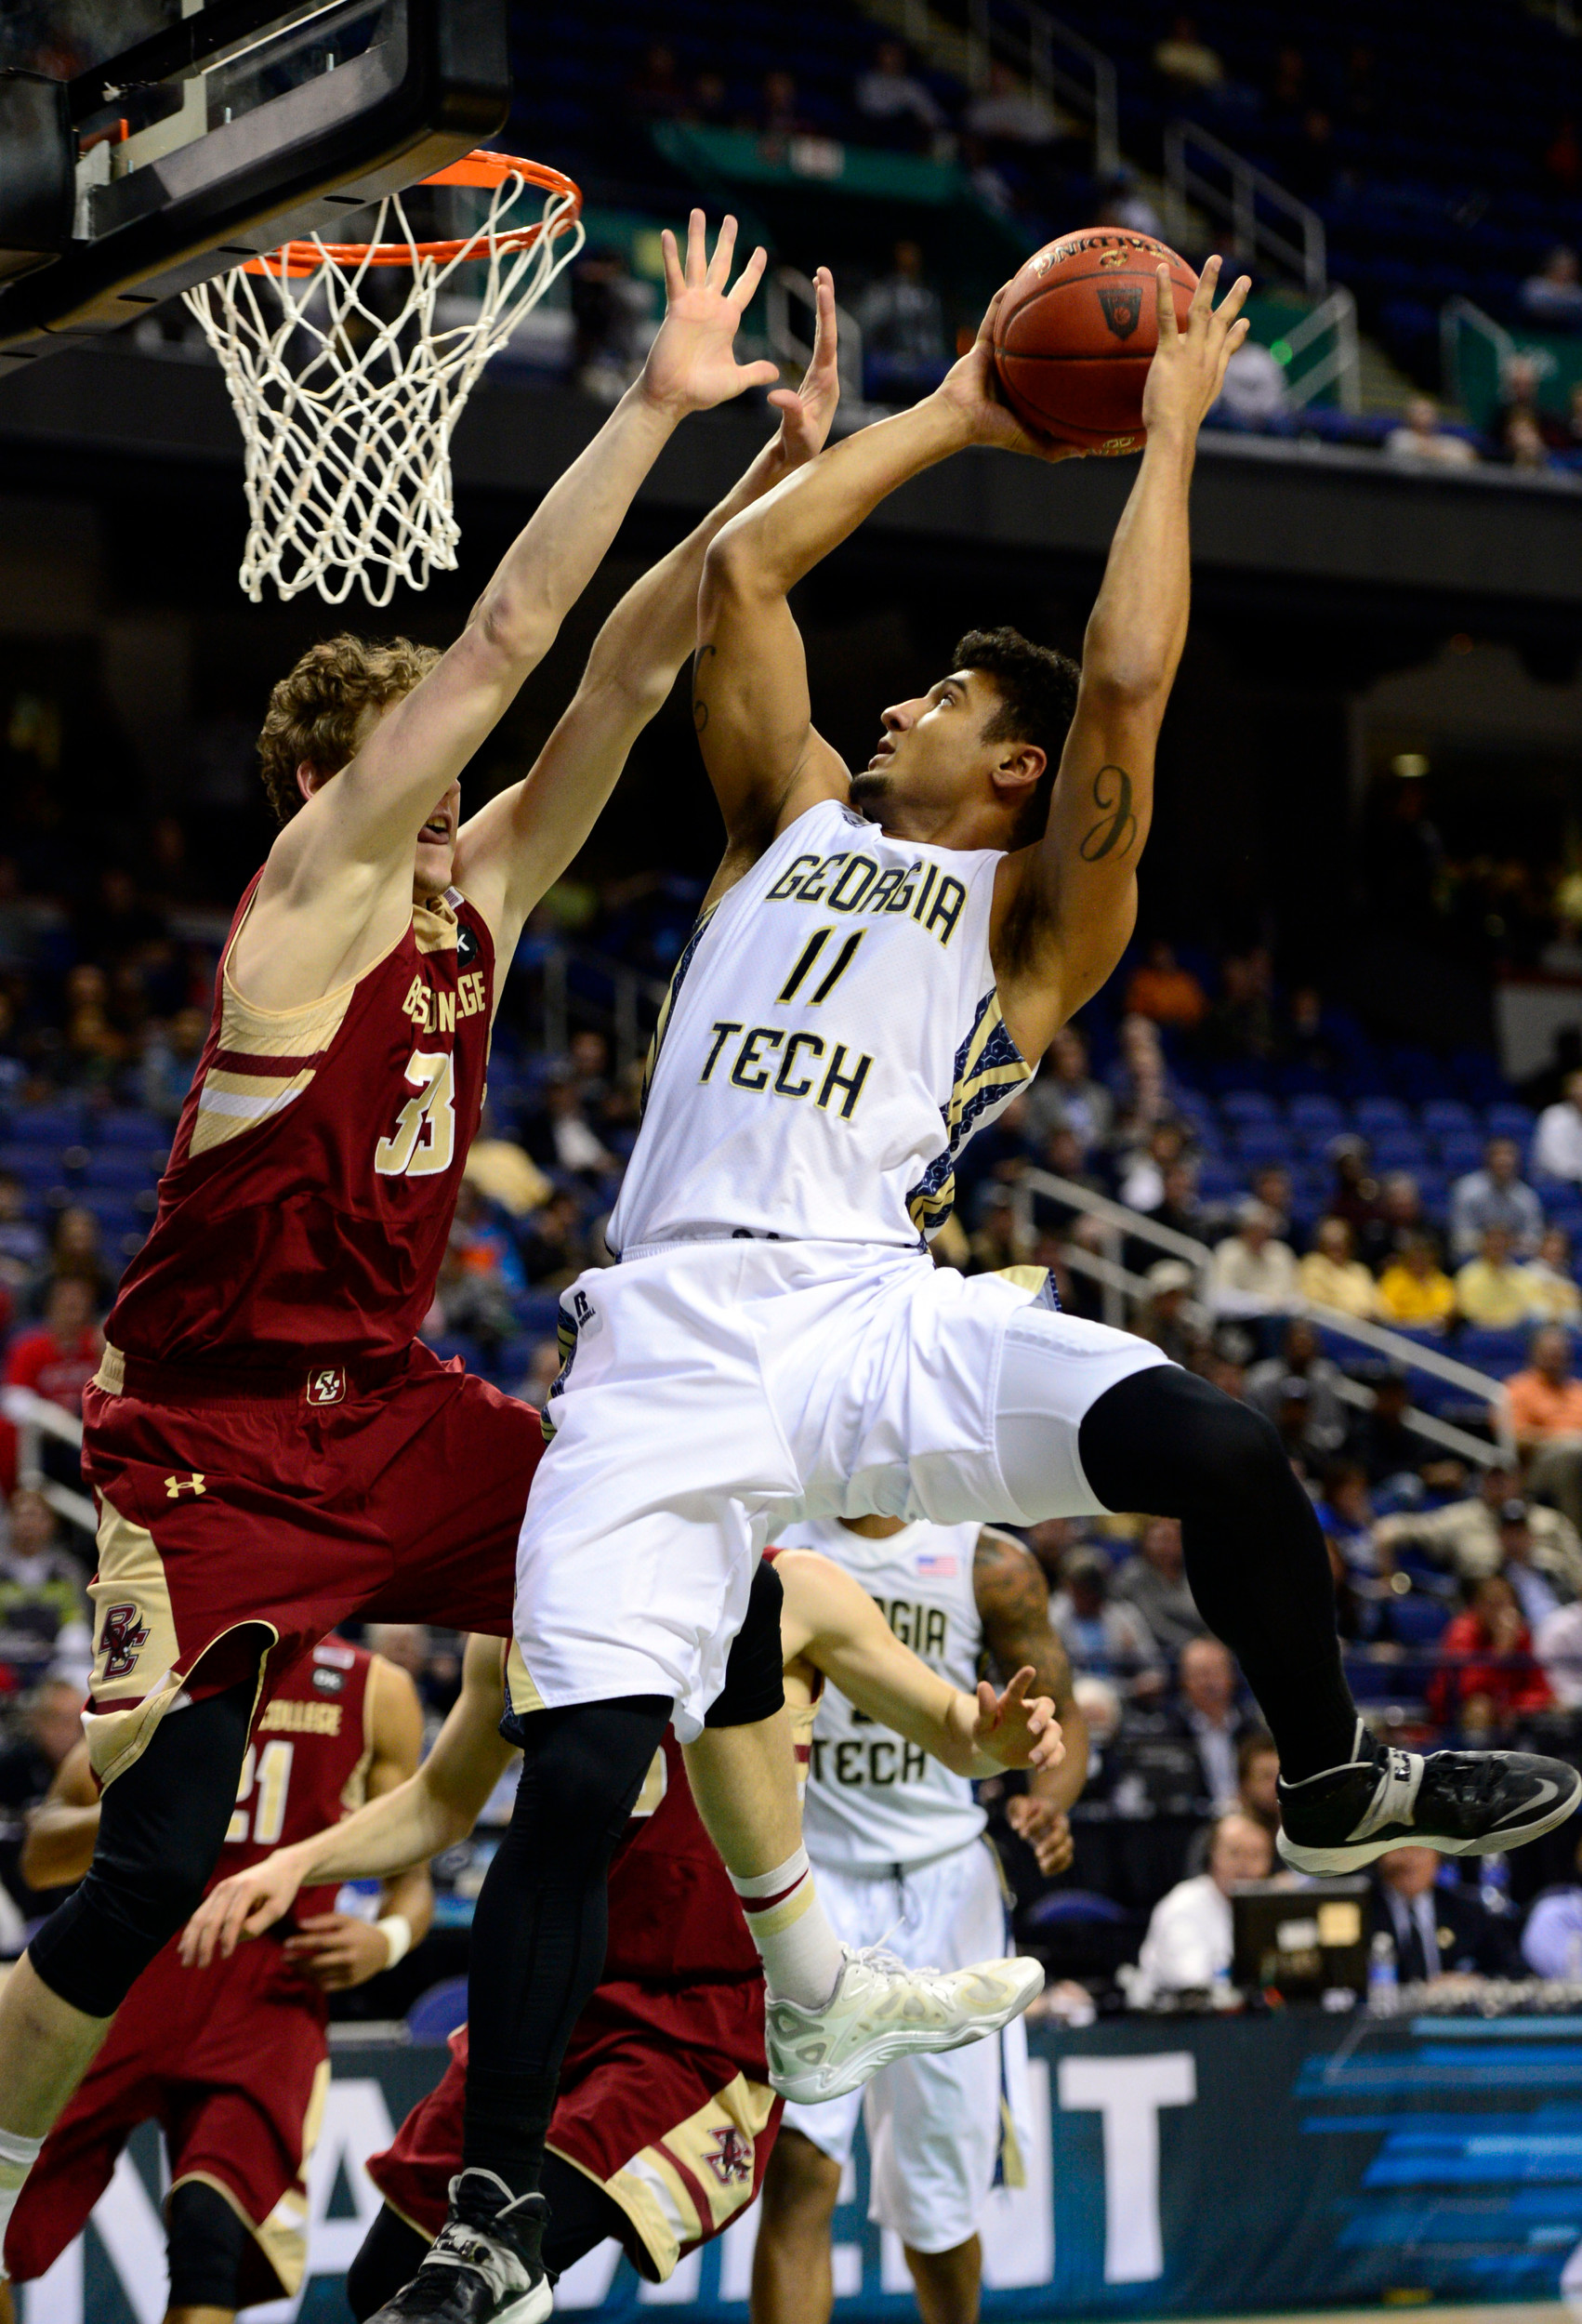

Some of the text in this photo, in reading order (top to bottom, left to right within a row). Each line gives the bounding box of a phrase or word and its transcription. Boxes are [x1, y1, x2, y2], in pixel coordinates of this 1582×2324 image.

[764, 852, 969, 950] GEORGIA
[774, 925, 868, 1007] 11
[697, 1020, 876, 1121] TECH
[374, 1049, 455, 1177] 33
[573, 1289, 589, 1318] R
[872, 1596, 947, 1659] GIA
[811, 1737, 927, 1786] TECH
